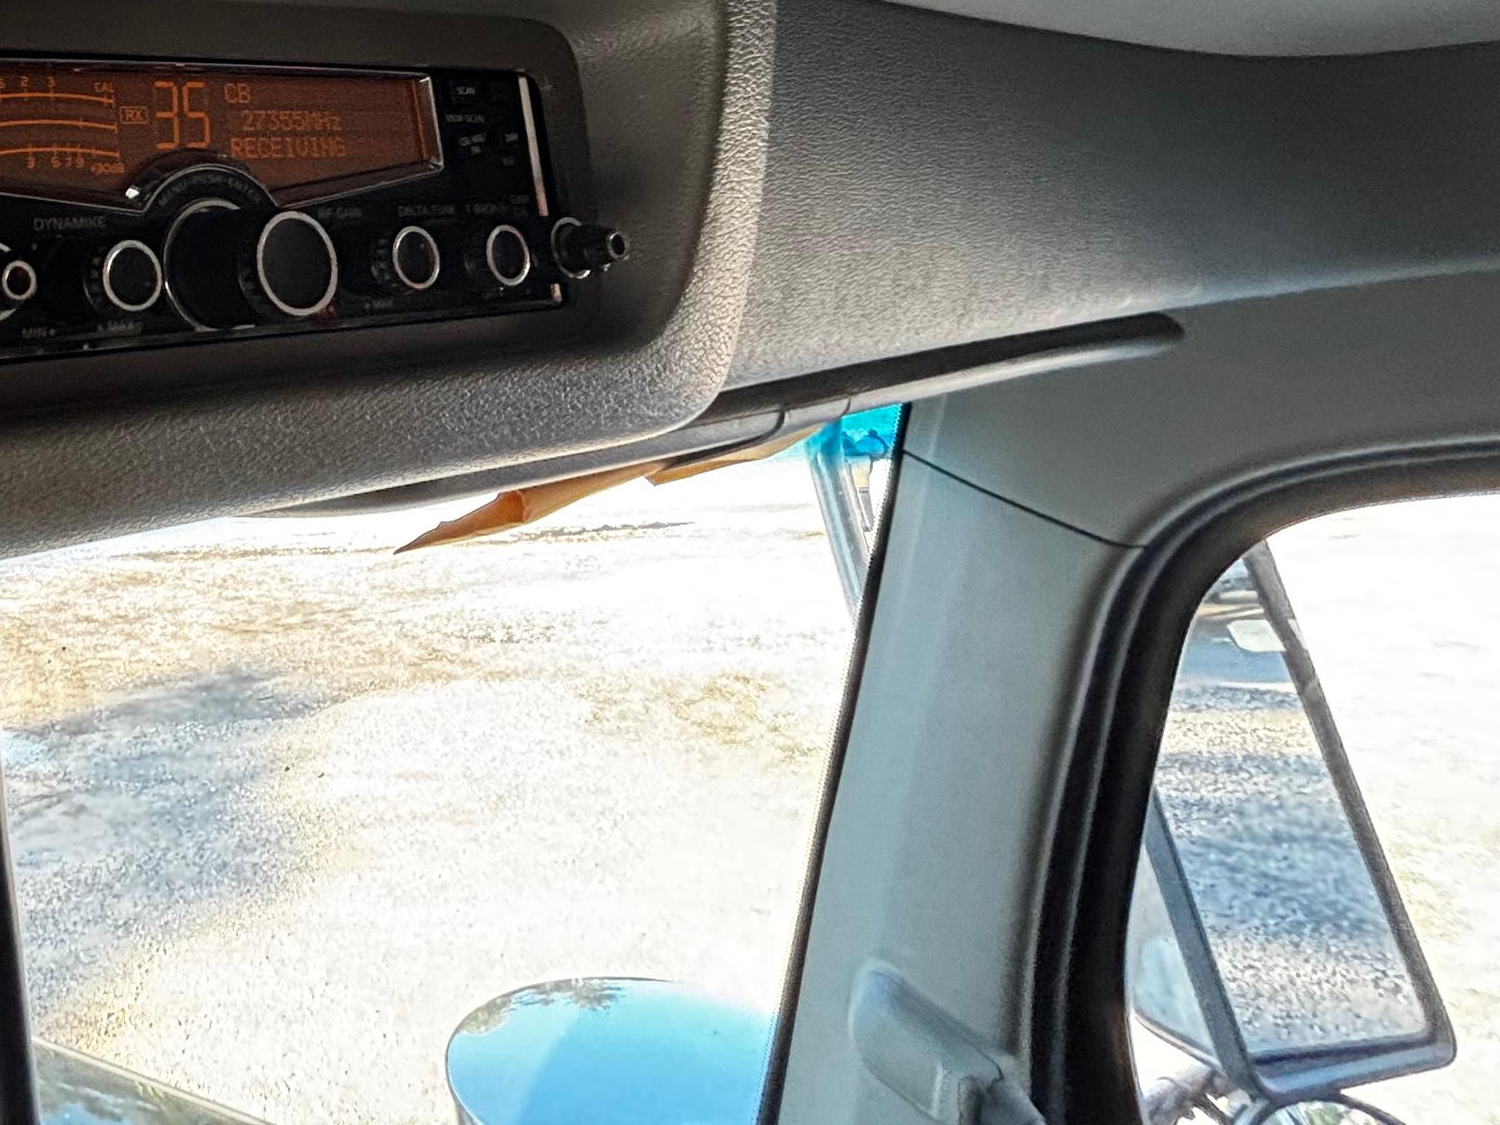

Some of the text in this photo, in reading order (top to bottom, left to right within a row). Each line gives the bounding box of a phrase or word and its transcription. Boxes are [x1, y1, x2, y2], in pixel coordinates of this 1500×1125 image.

[20, 76, 31, 87] 2
[47, 76, 57, 88] 3
[224, 83, 251, 104] CB
[154, 81, 211, 150] 35
[230, 136, 348, 159] RECEIVING
[33, 216, 107, 231] DYNAMIKE
